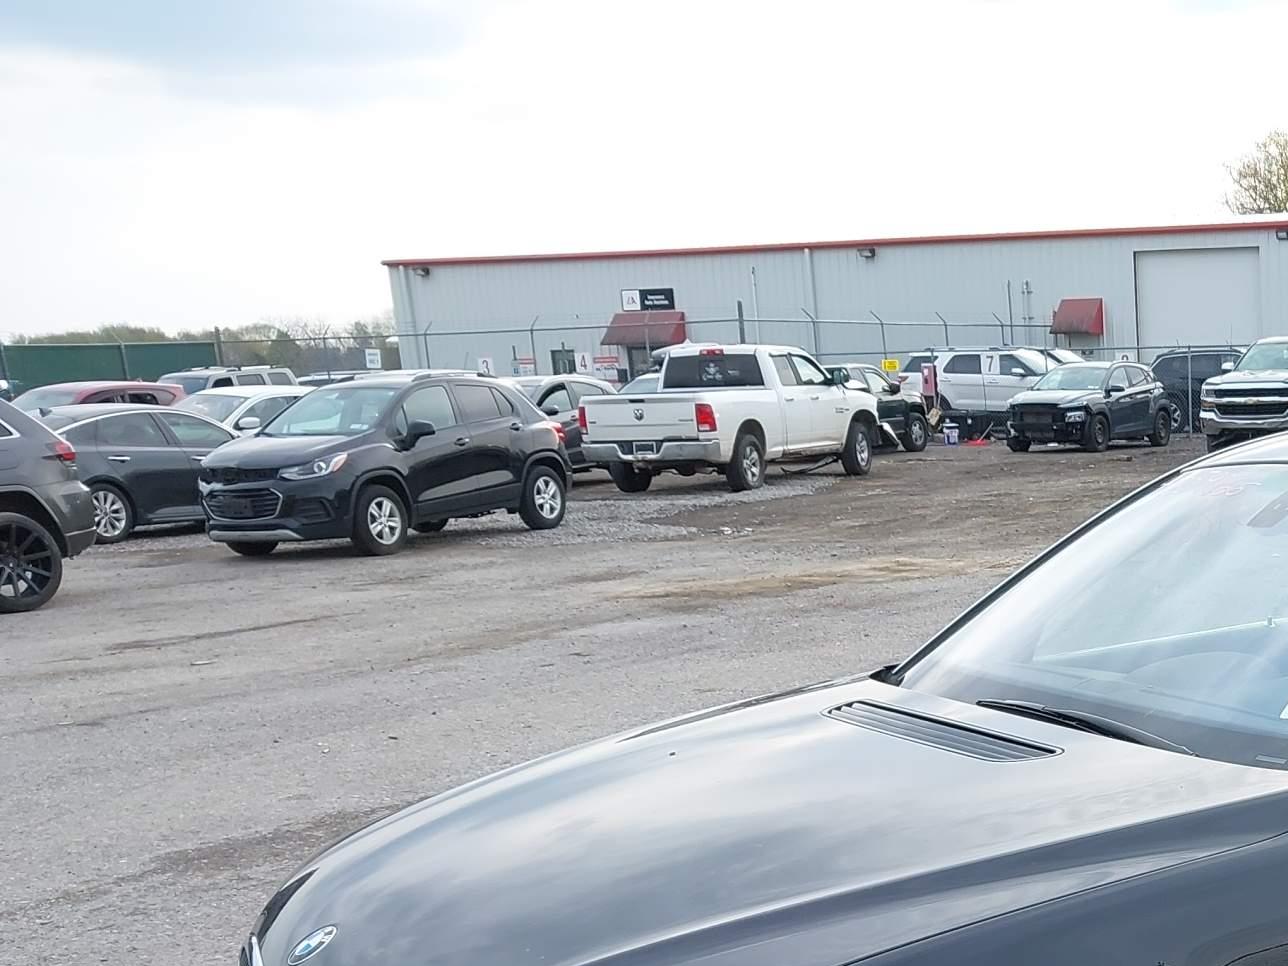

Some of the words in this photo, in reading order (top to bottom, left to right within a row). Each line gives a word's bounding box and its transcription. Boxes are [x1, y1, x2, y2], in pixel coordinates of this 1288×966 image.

[482, 360, 490, 375] 3
[580, 355, 587, 370] 4
[986, 356, 994, 372] 7
